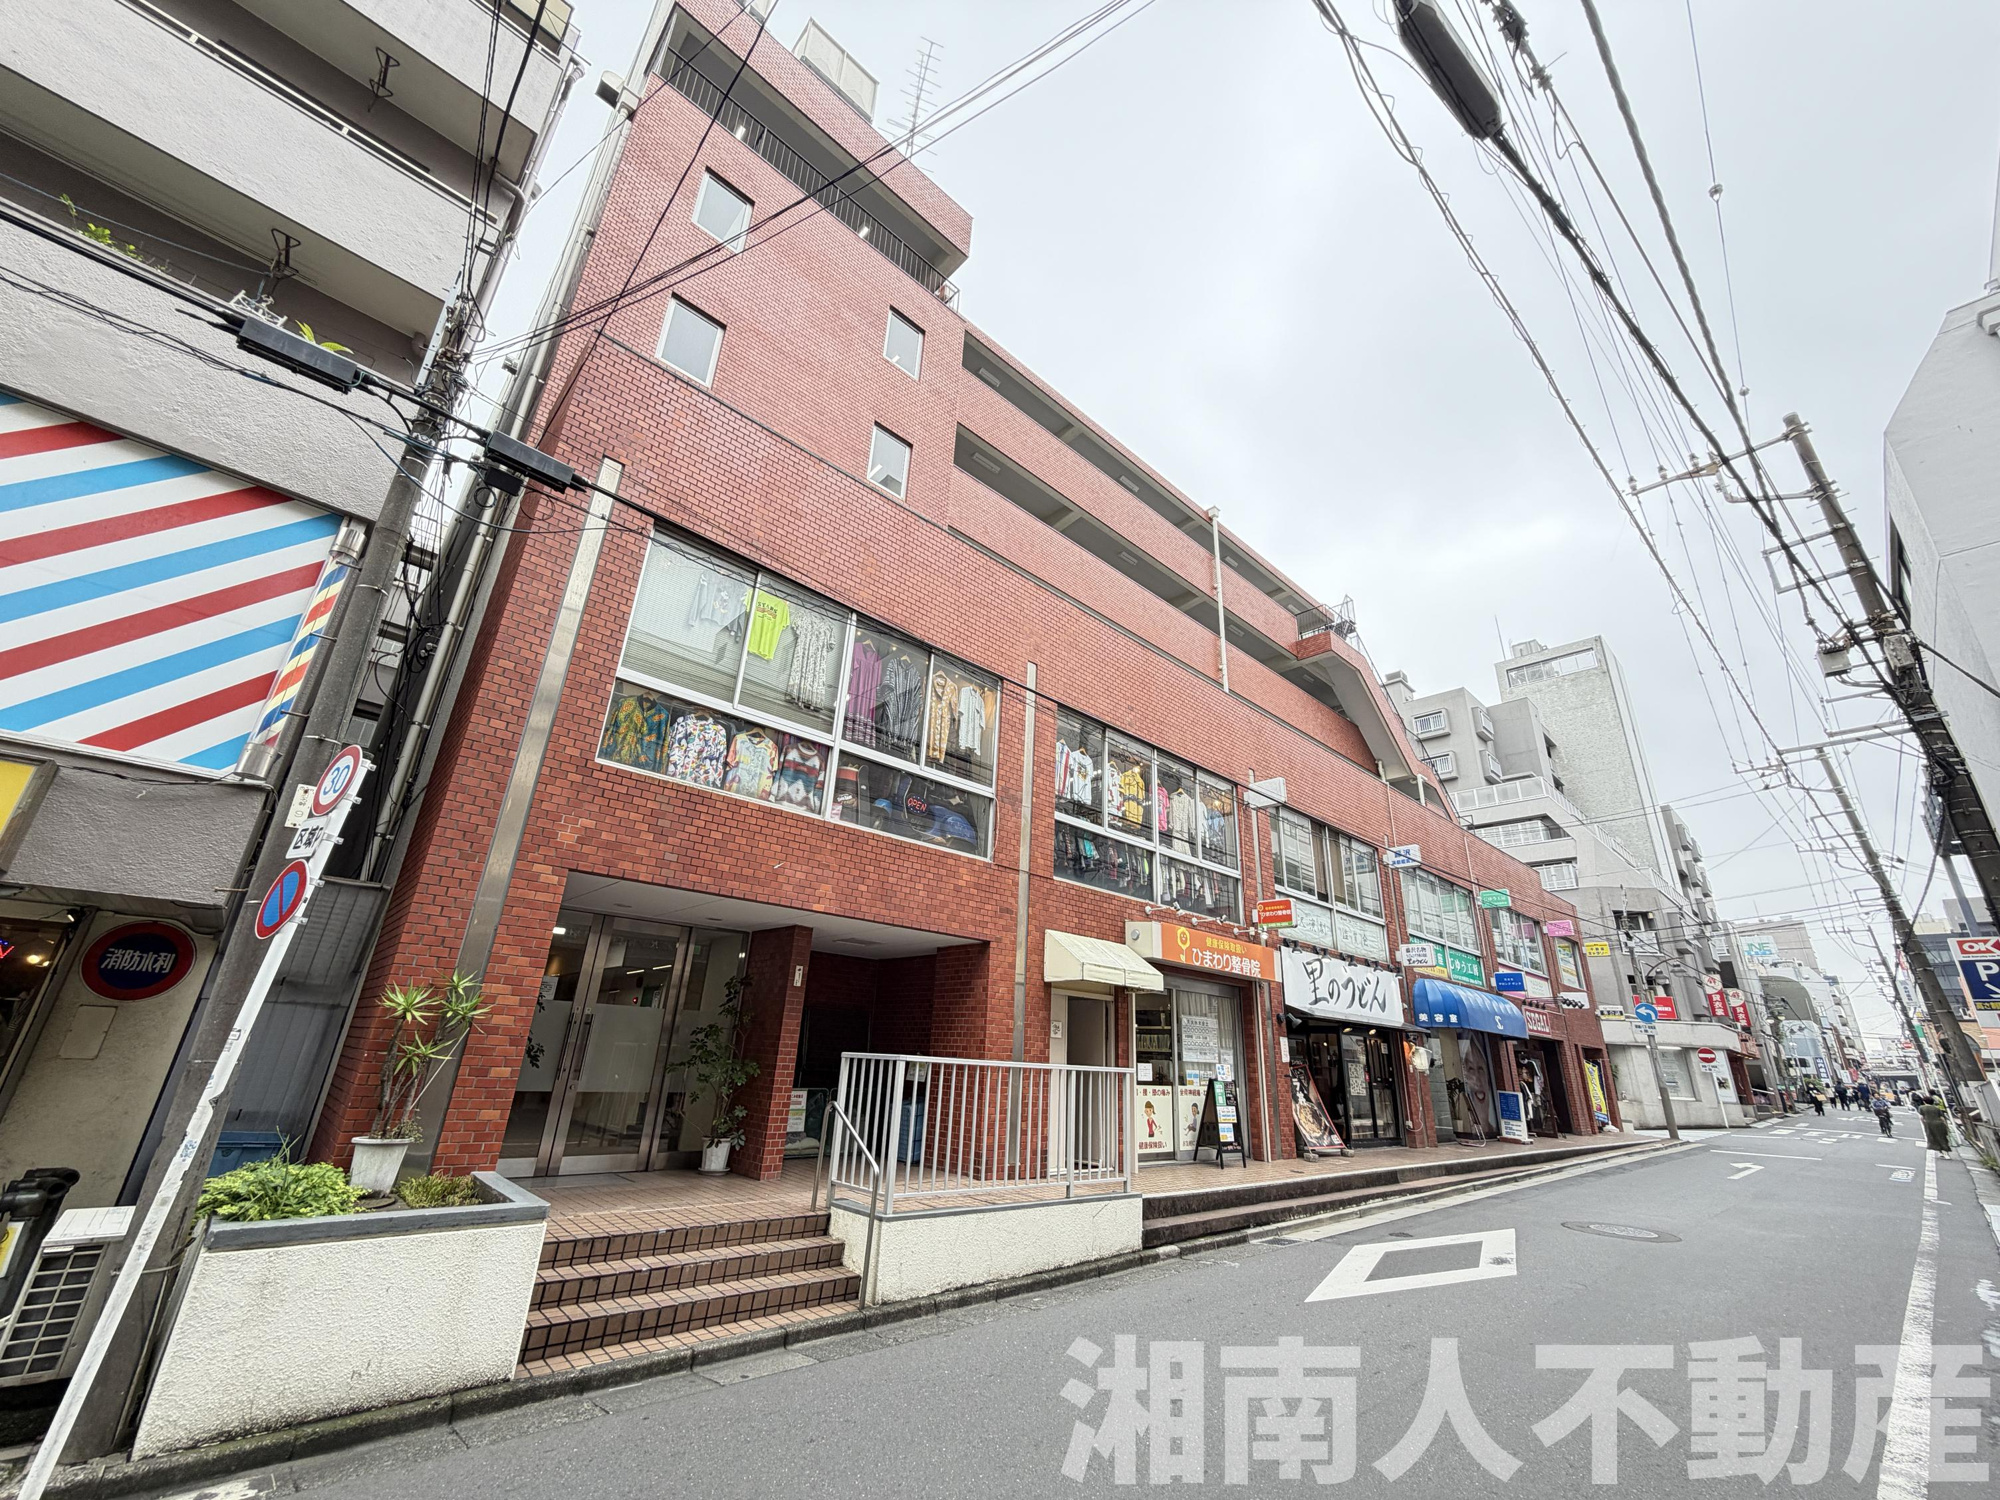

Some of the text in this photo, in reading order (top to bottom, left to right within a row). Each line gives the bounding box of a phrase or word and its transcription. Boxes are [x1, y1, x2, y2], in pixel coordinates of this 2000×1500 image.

[322, 764, 351, 796] 30
[907, 797, 927, 812] OPEN
[1962, 940, 2000, 953] OK
[101, 948, 176, 974] 消防水利
[1191, 947, 1261, 978] ひまわり整骨院
[1975, 961, 2000, 982] P
[1302, 957, 1387, 1013] 里のうどん
[1418, 1013, 1458, 1024] 美容室
[1525, 1010, 1550, 1033] SEGAL
